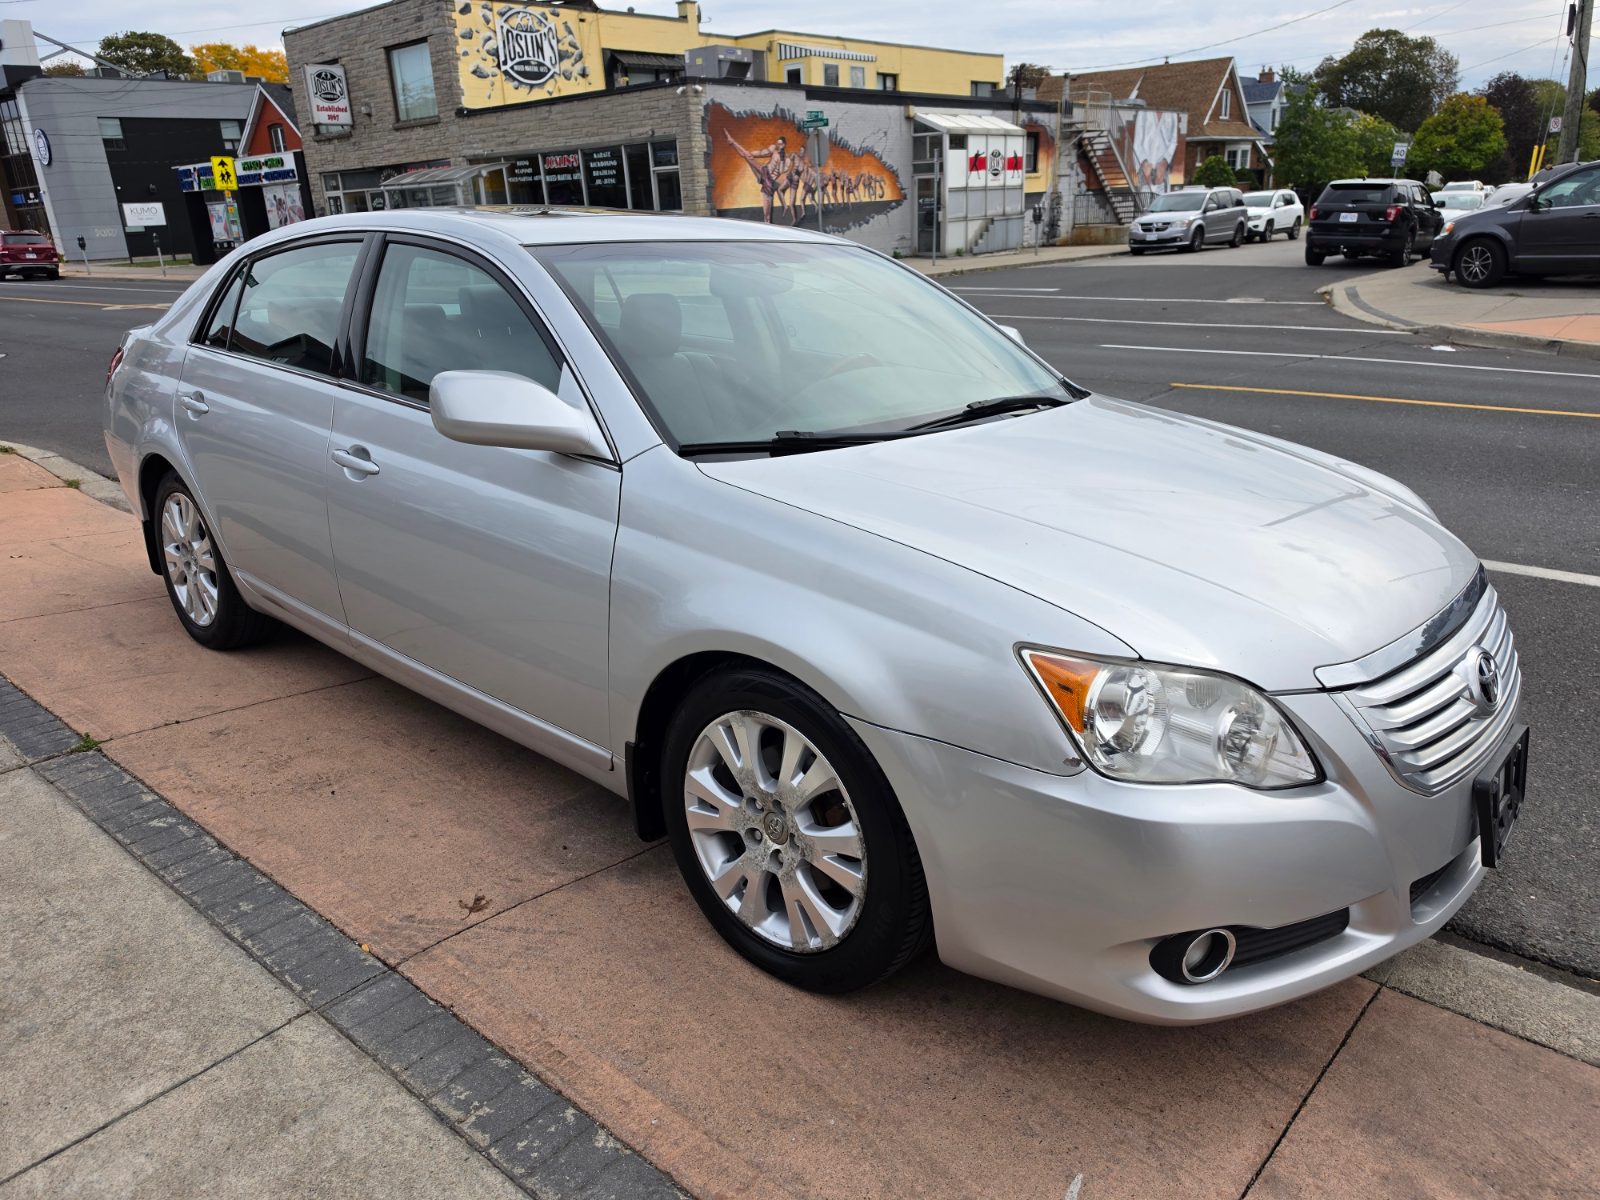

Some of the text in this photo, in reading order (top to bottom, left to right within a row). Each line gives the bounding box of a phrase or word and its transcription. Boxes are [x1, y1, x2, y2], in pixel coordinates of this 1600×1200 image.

[500, 25, 558, 66] JOSLIN'S
[313, 76, 344, 96] JOSLIN'S
[316, 104, 348, 112] Established
[129, 207, 158, 215] KUMO
